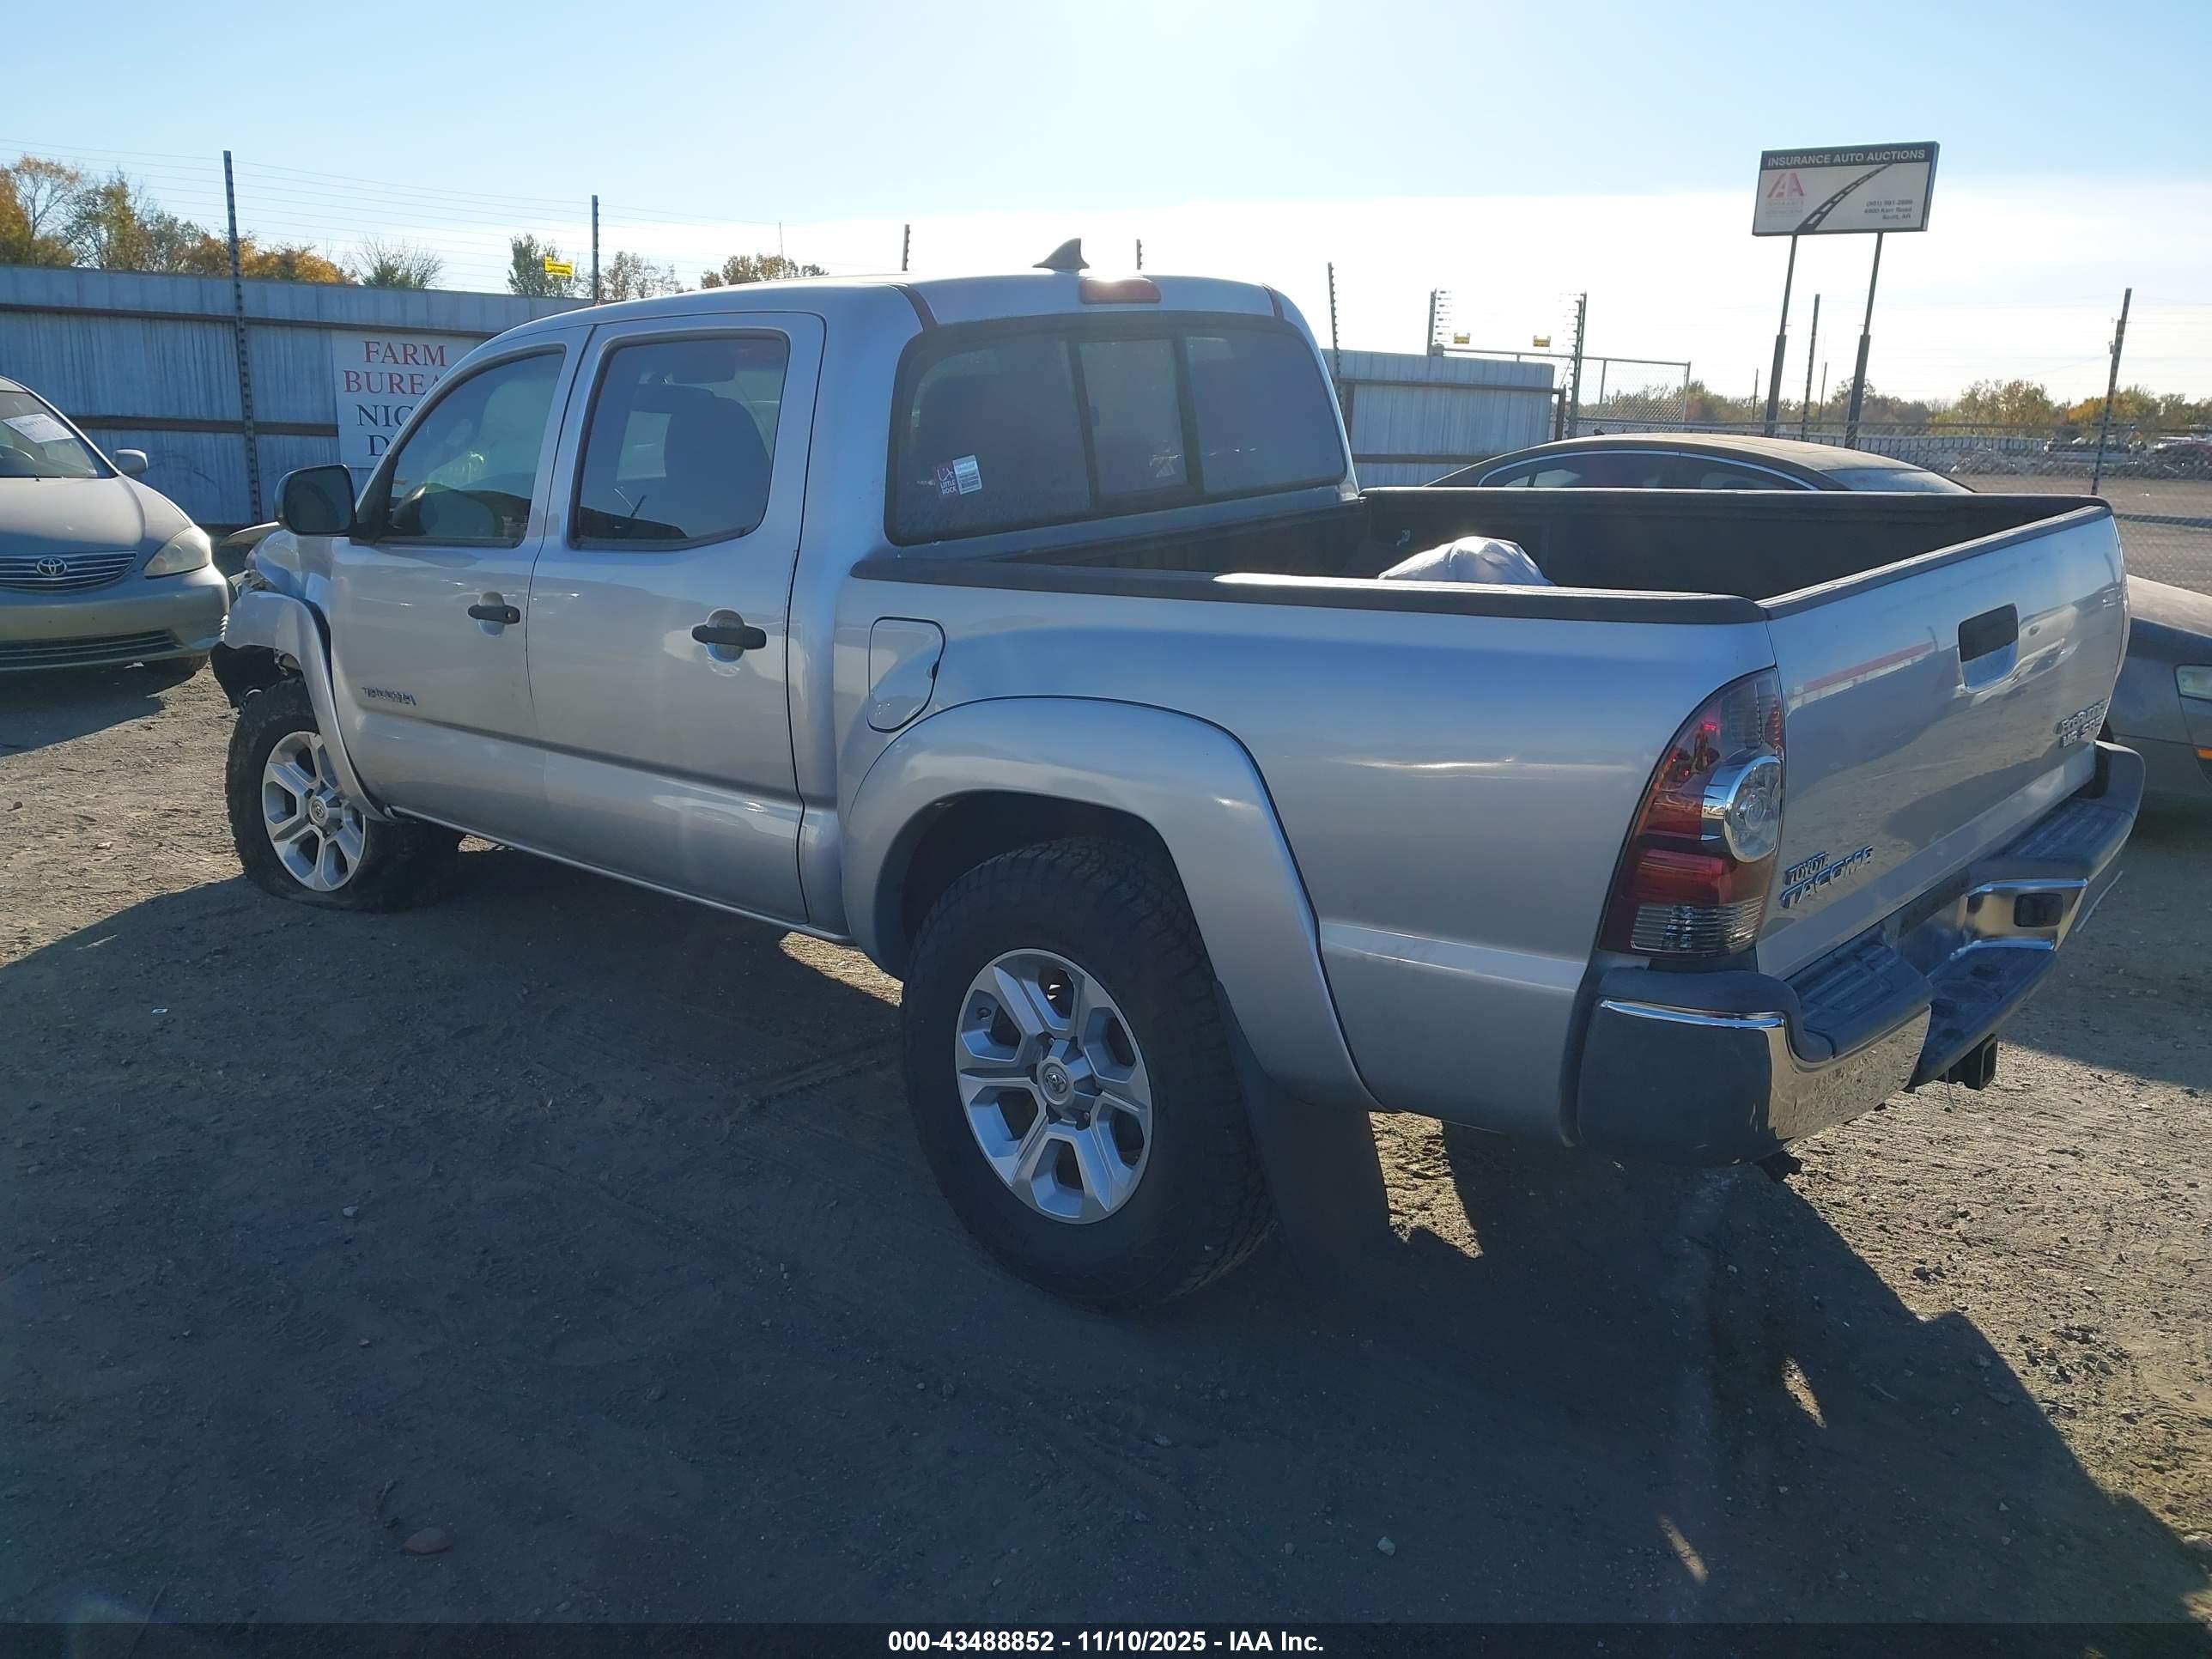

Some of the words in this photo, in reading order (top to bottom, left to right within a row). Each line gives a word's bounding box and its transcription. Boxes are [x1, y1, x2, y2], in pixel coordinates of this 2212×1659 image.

[1767, 155, 1832, 167] INSURANCE
[1832, 152, 1864, 163] AUTO
[1866, 149, 1926, 161] AUCTIONS
[363, 341, 447, 367] FARM
[940, 479, 956, 489] LITTLE
[942, 486, 957, 495] ROCK
[1780, 845, 1873, 908] TACOMA
